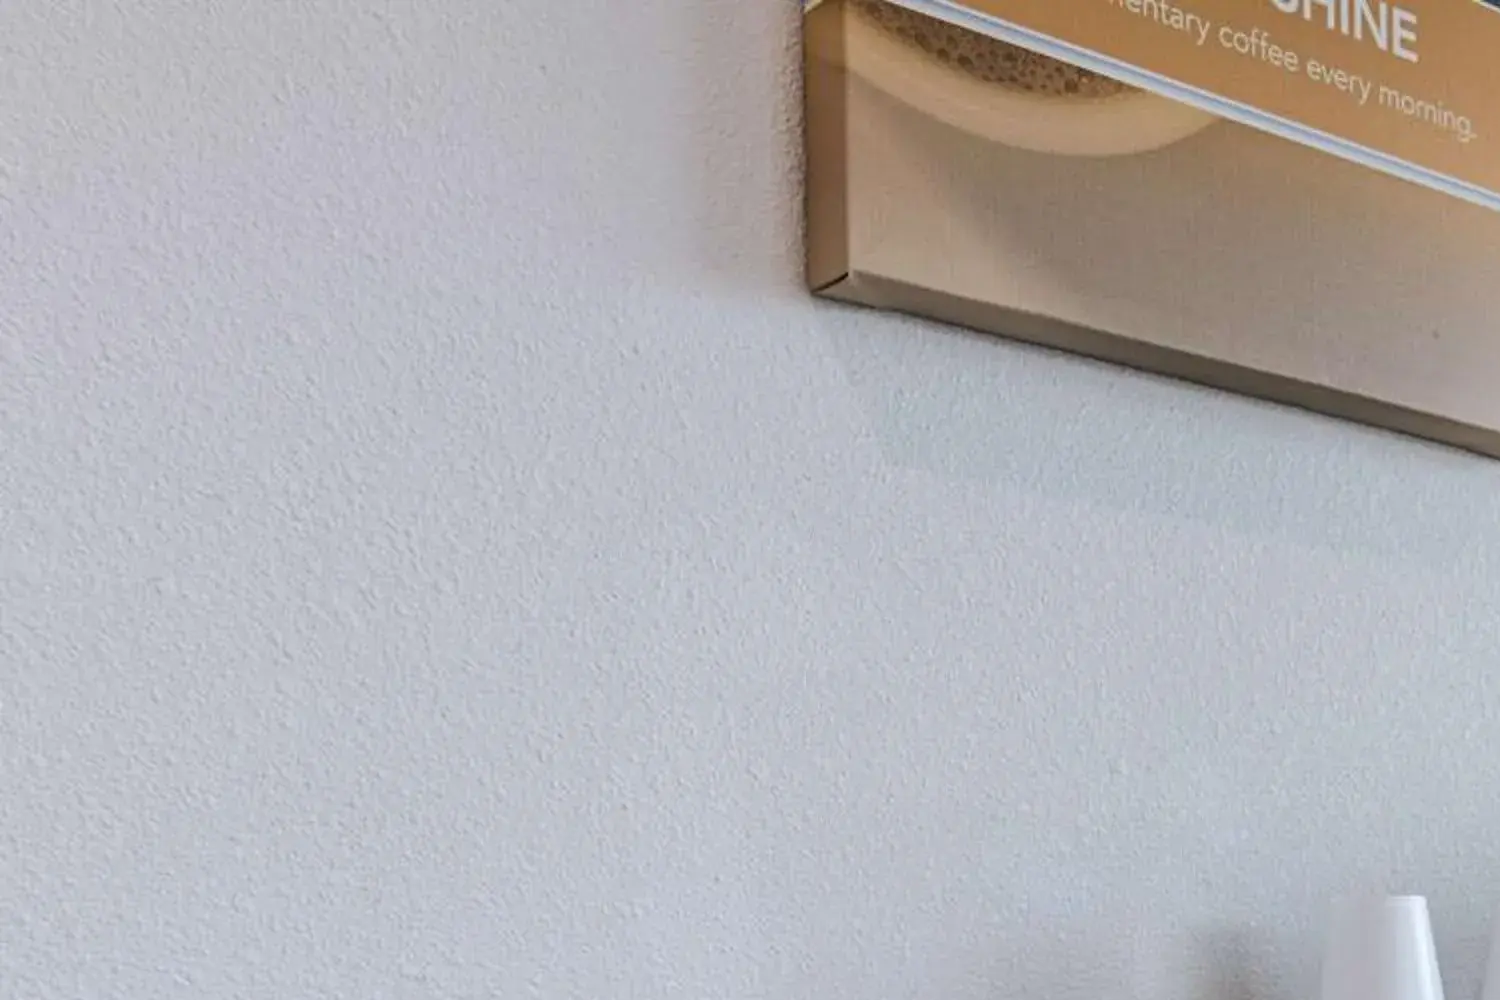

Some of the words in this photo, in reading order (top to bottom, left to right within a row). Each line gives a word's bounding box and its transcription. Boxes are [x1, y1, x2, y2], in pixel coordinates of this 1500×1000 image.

[1219, 25, 1300, 72] coffee
[1306, 58, 1371, 105] every
[1378, 83, 1478, 144] morning.
